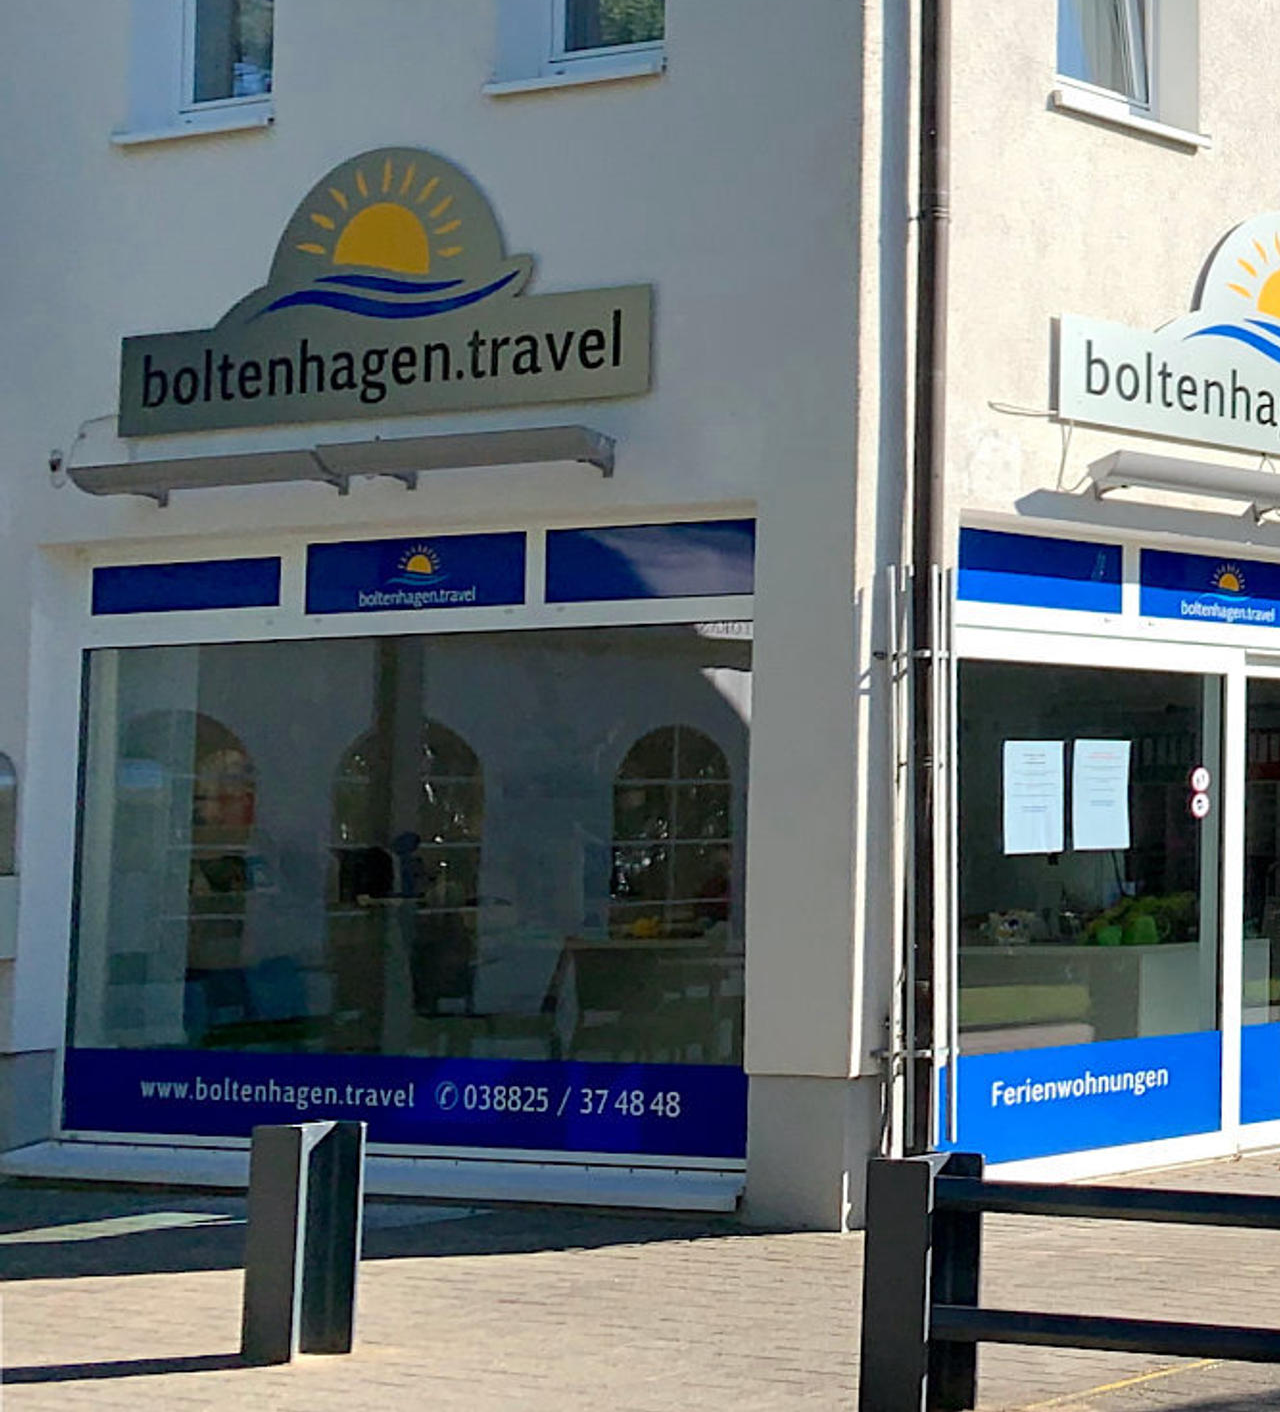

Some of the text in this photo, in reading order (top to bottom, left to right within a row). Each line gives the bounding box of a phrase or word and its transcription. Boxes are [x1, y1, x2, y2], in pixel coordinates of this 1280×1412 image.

[141, 309, 622, 407] boltenhagen.travel
[358, 586, 476, 608] boltenhagen.travel
[1180, 599, 1276, 623] boltenhagen.travel
[139, 1077, 415, 1110] www.boltenhagen.travel
[464, 1084, 549, 1113] 038825
[579, 1089, 608, 1115] 37
[614, 1090, 644, 1117] 48
[649, 1091, 681, 1118] 48
[991, 1066, 1169, 1107] Ferienwohnungen
